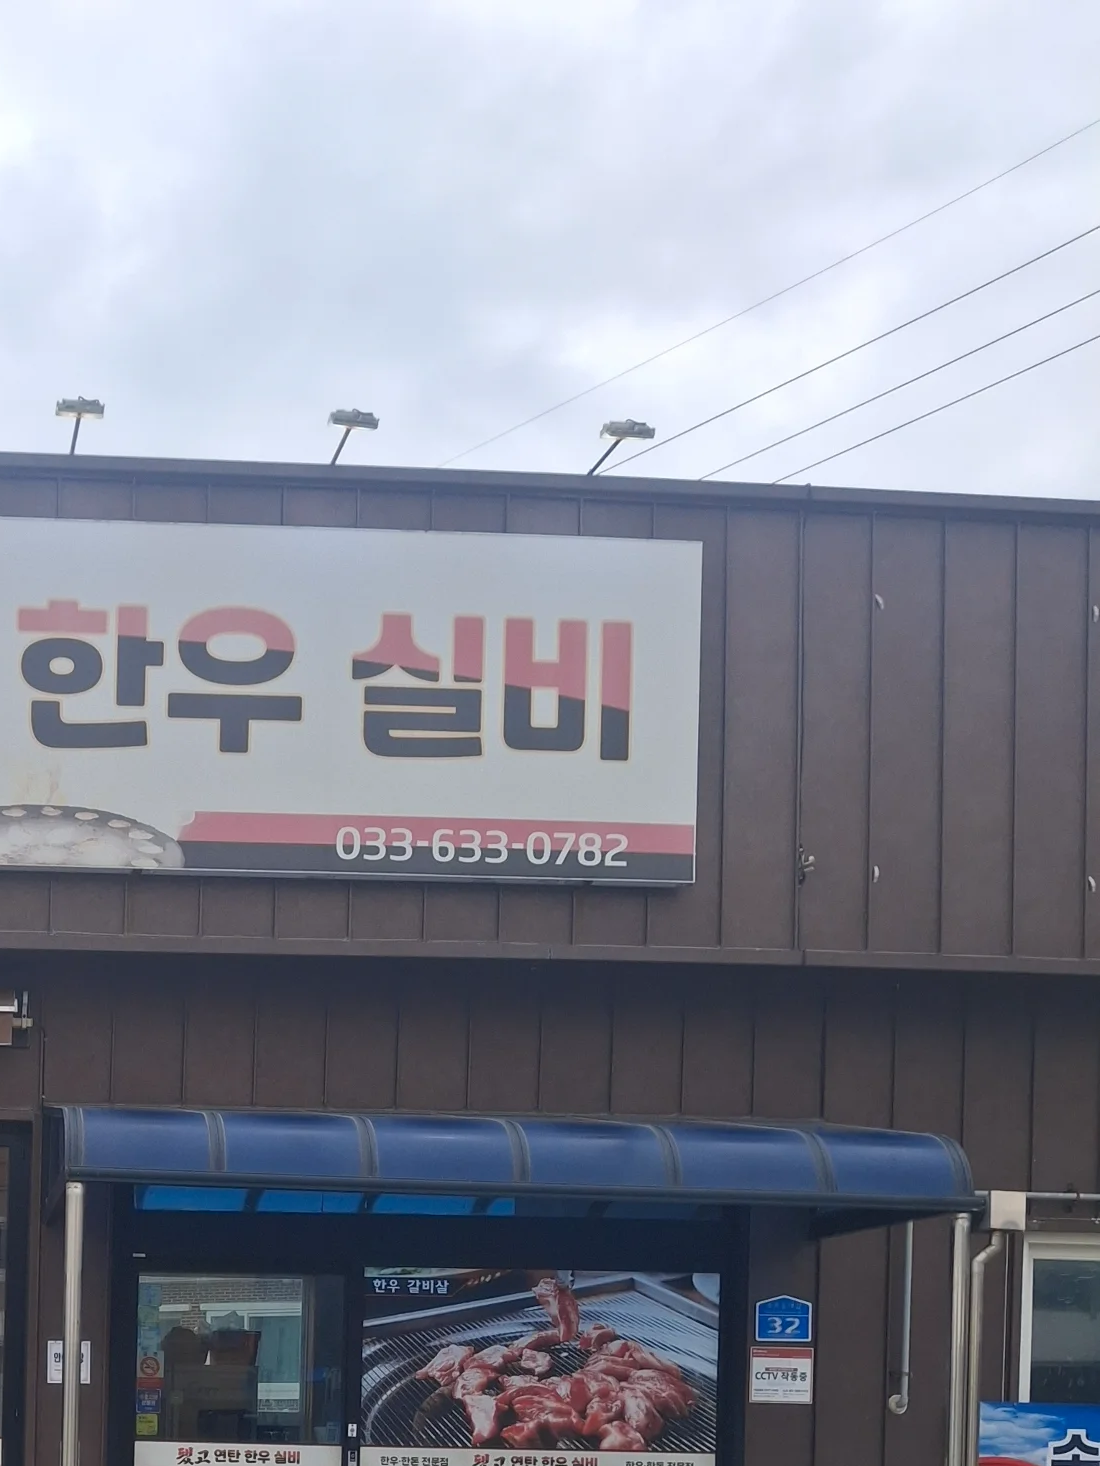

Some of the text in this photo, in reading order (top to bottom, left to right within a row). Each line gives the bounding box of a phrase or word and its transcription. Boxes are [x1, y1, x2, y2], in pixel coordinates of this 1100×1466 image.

[17, 599, 303, 754] 한우
[352, 613, 634, 762] 실비
[335, 825, 630, 868] 033-633-0782
[372, 1278, 450, 1294] 한우 갈비살
[767, 1316, 801, 1334] 32
[755, 1371, 808, 1382] CCTV 작동중
[214, 1449, 241, 1463] 연탄
[244, 1450, 270, 1464] 한우
[274, 1450, 300, 1465] 실비
